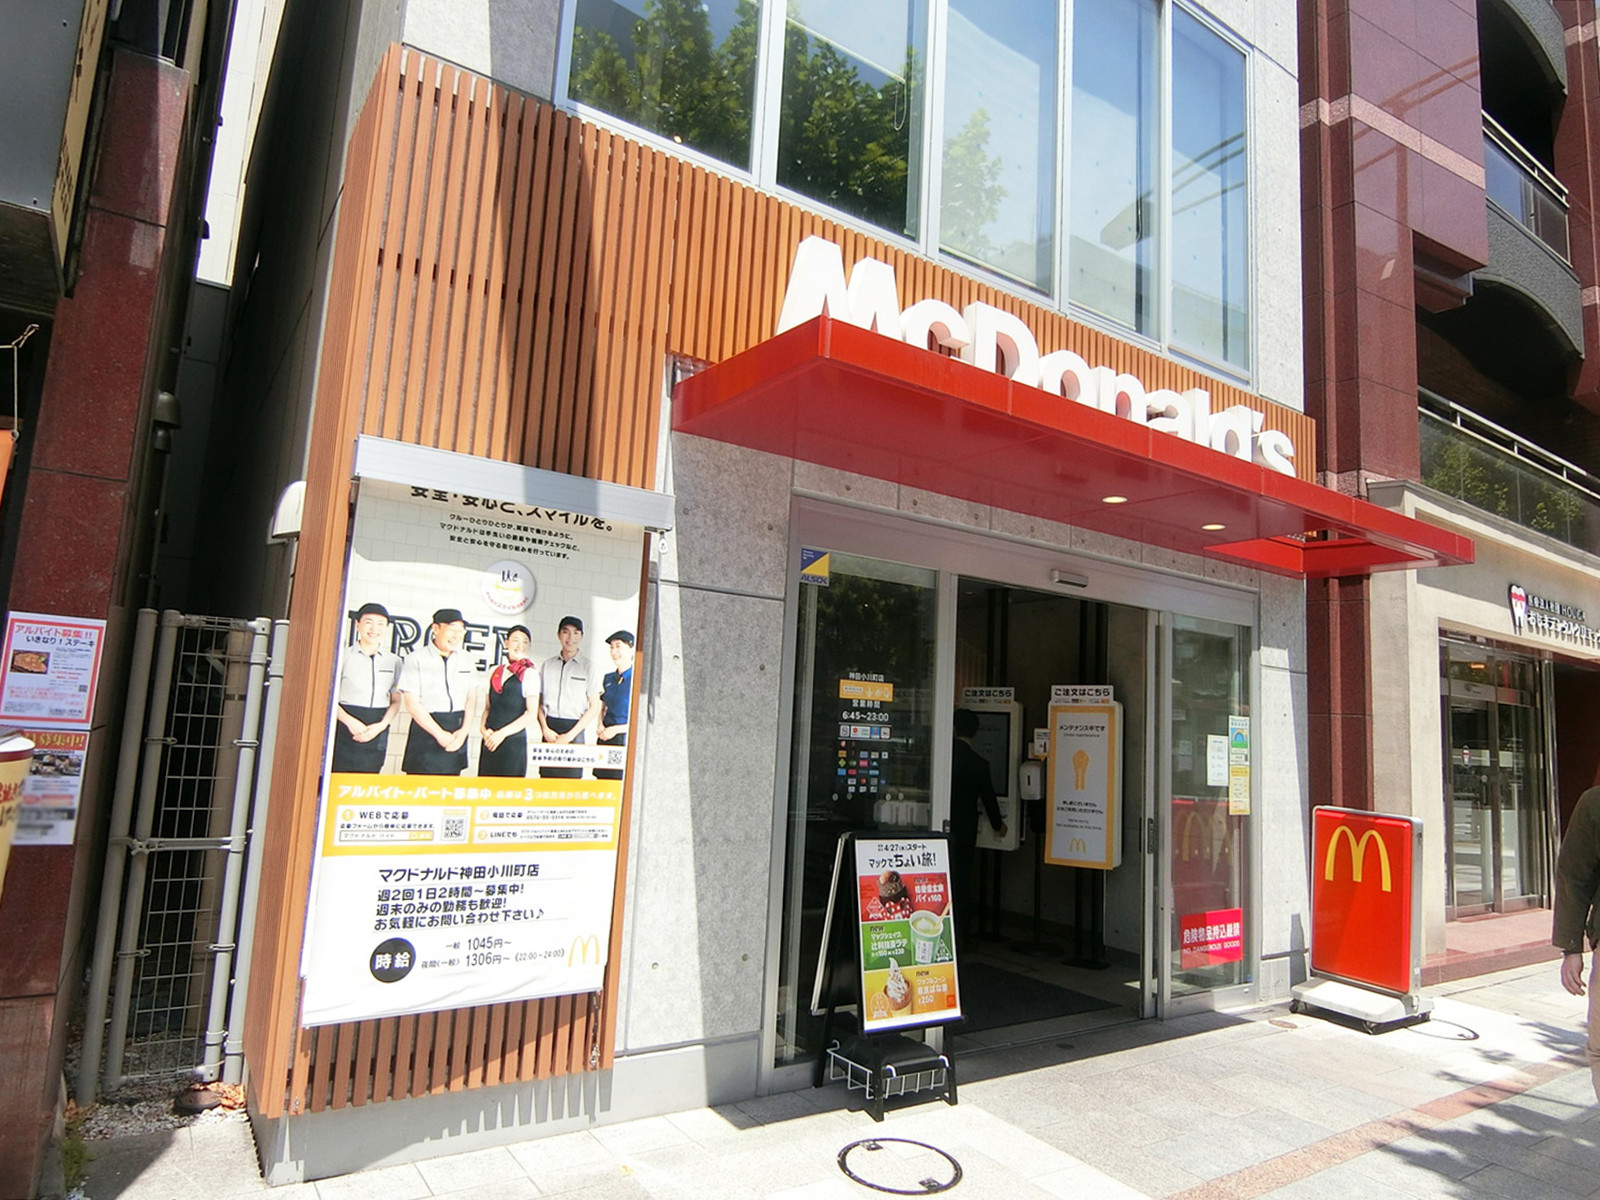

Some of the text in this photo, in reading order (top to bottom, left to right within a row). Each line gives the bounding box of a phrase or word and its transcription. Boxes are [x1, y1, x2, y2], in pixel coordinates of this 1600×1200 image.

[776, 234, 1297, 478] McDonald's
[801, 574, 828, 585] ALSOK
[964, 689, 1012, 698] ご注文はこちら
[1055, 687, 1111, 697] ご注文はこちら
[1059, 724, 1106, 732] メンテナンス中です
[869, 852, 937, 868] マックでちょい旅!
[378, 863, 540, 883] マクドナルド神田小川町店
[376, 898, 507, 917] 週末のみの勤務も歓迎!
[374, 952, 411, 970] 時給
